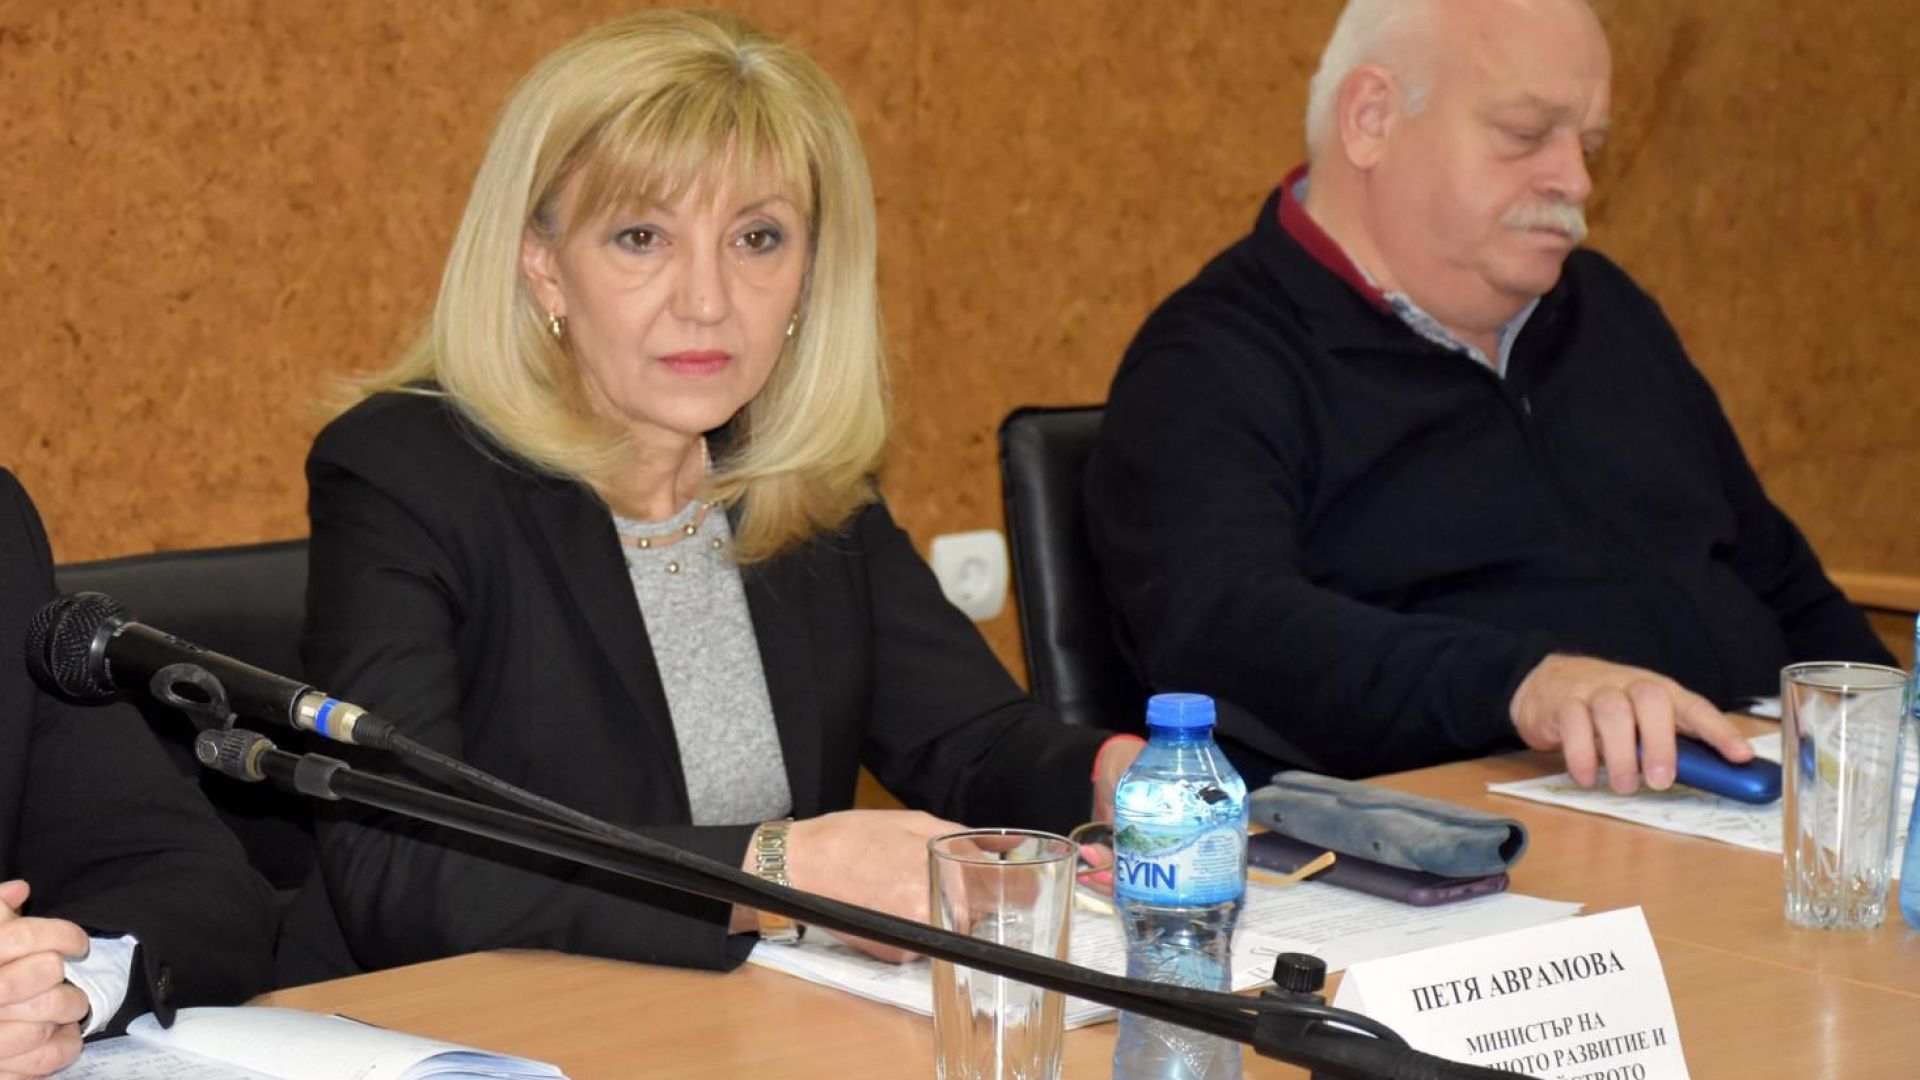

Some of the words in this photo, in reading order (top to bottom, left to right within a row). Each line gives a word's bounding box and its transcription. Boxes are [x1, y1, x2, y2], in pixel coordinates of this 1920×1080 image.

[1411, 976, 1484, 1012] ПЕТЯ
[1489, 950, 1625, 998] АВРАМОВА
[1466, 1016, 1573, 1056] МИНИСТЪР
[1577, 1011, 1606, 1033] НА
[1553, 1031, 1650, 1068] РАЗВИТИЕ
[1652, 1027, 1667, 1047] И
